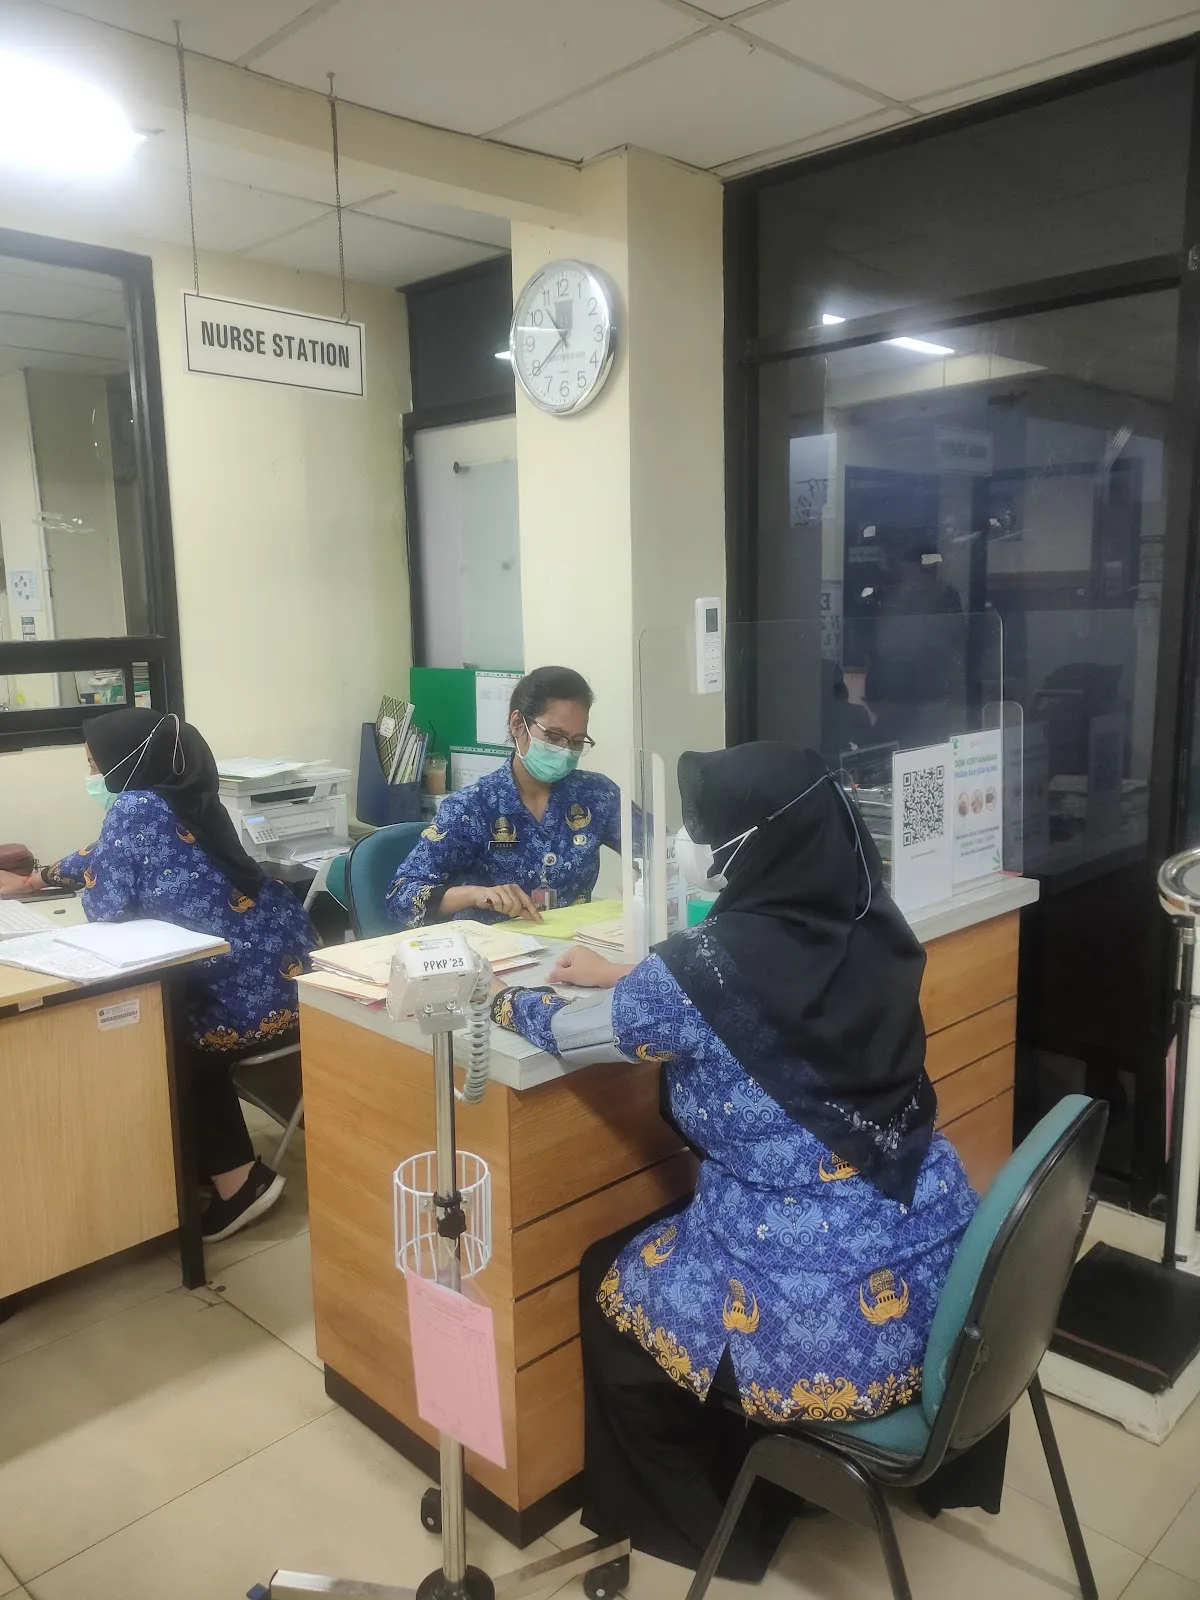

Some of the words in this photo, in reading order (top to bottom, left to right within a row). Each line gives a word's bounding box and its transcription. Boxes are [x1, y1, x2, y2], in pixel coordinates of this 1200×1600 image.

[556, 278, 569, 297] 12
[577, 281, 581, 298] 1
[542, 289, 550, 306] 11
[587, 297, 598, 316] 2
[529, 309, 544, 327] 10
[593, 324, 604, 343] 3
[201, 320, 266, 355] NURSE
[272, 333, 350, 369] STATION
[525, 335, 536, 353] 9
[532, 360, 541, 376] 8
[589, 352, 599, 367] 4
[544, 376, 553, 393] 7
[577, 370, 587, 388] 5
[559, 381, 570, 397] 6
[423, 958, 448, 972] PPKP
